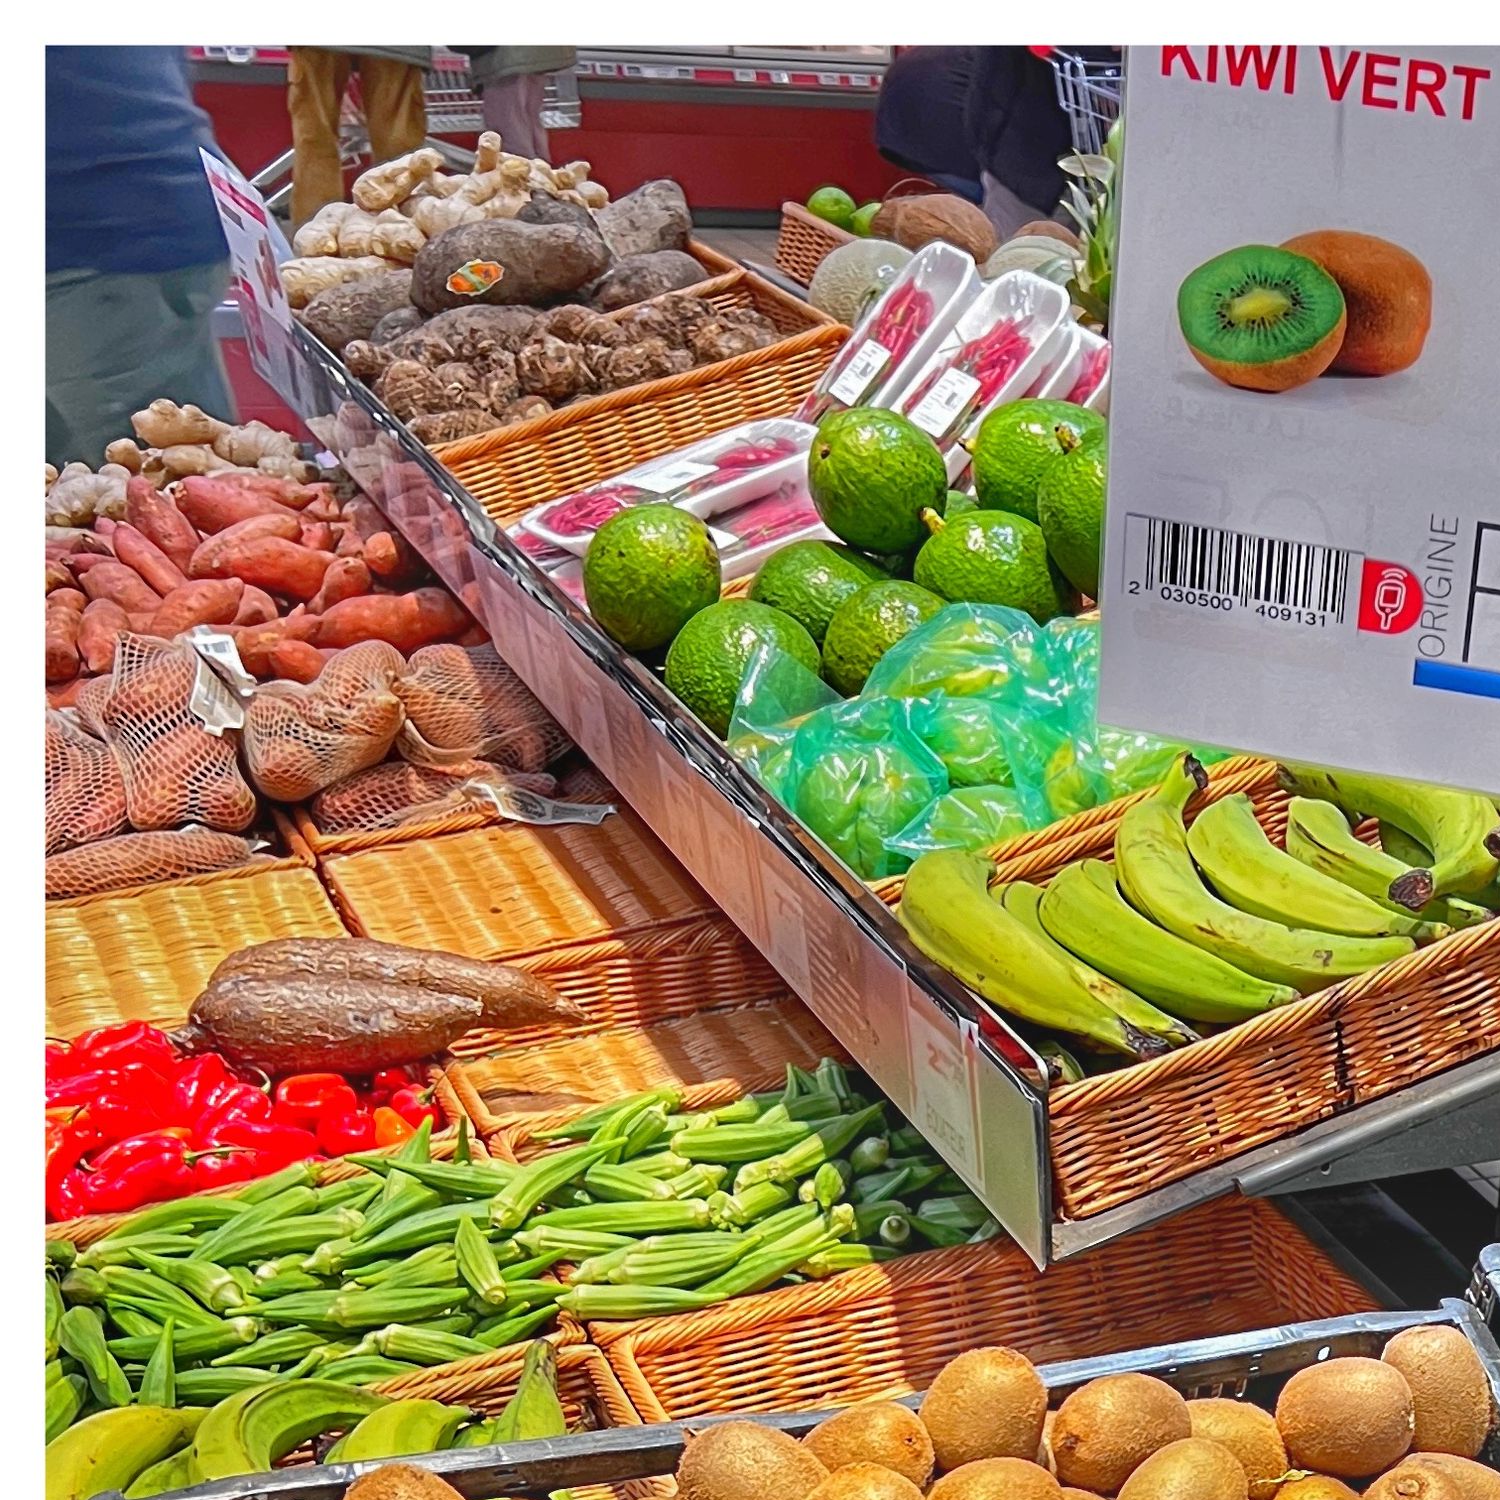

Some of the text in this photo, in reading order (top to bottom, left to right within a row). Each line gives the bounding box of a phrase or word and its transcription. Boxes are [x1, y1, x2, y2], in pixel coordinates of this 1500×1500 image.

[1160, 44, 1298, 95] KIWI
[1318, 45, 1492, 121] VERT
[1128, 581, 1327, 628] 2 030500 409131
[1417, 513, 1459, 658] ORIGINE
